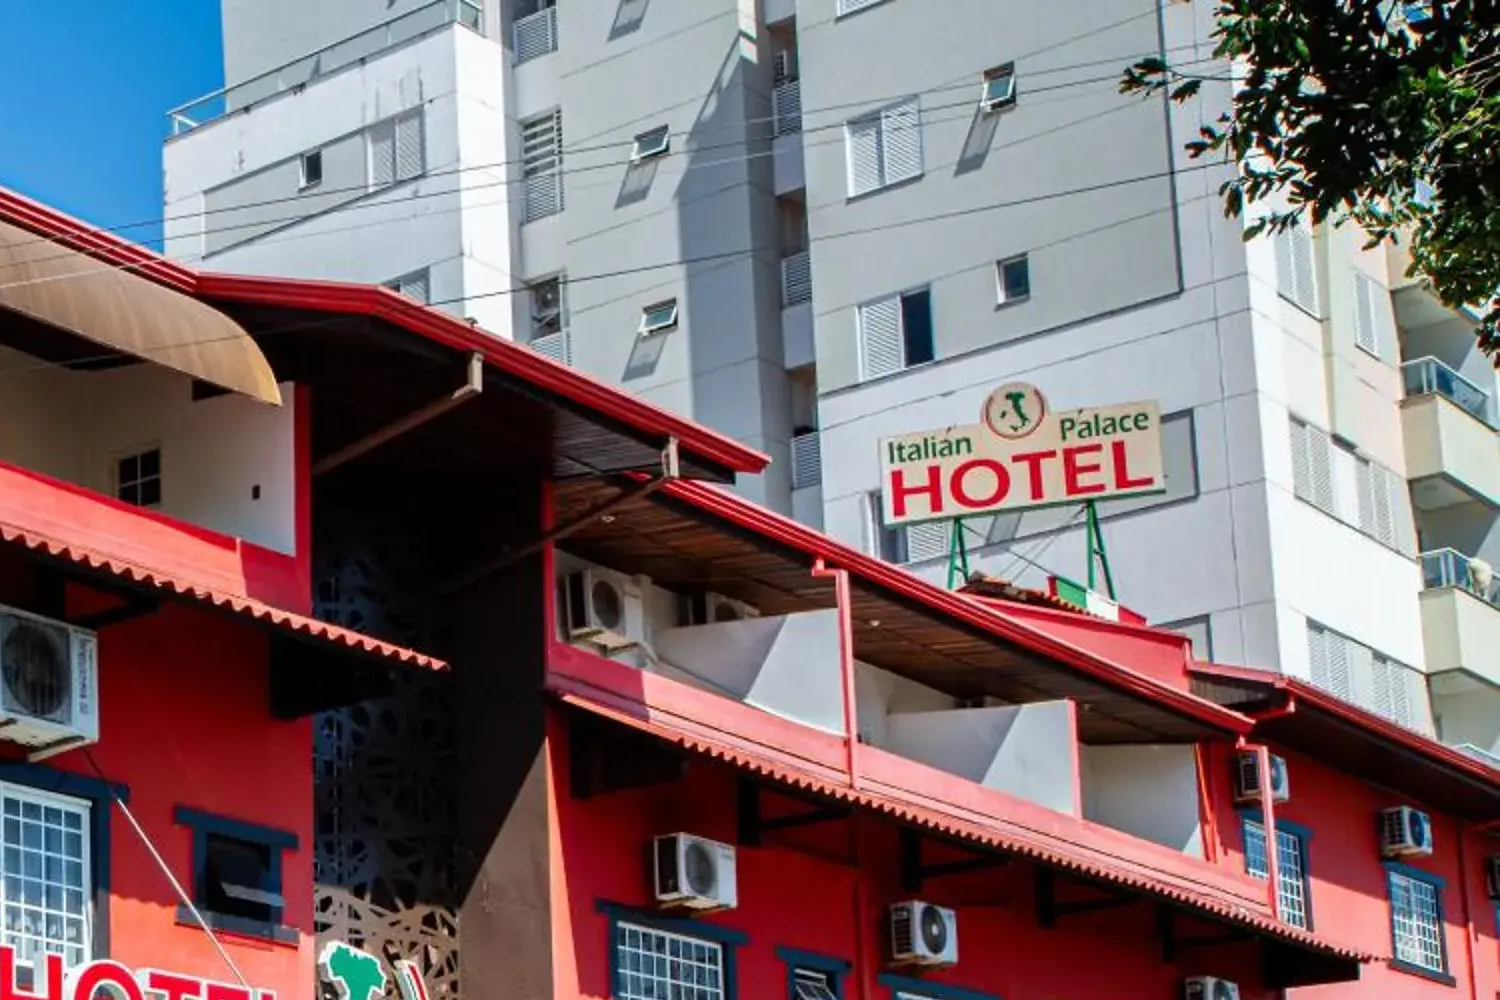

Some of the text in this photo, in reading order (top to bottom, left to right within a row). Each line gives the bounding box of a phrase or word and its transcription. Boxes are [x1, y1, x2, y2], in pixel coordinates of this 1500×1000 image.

[888, 411, 1150, 464] Italian Palace
[890, 440, 1155, 517] HOTEL
